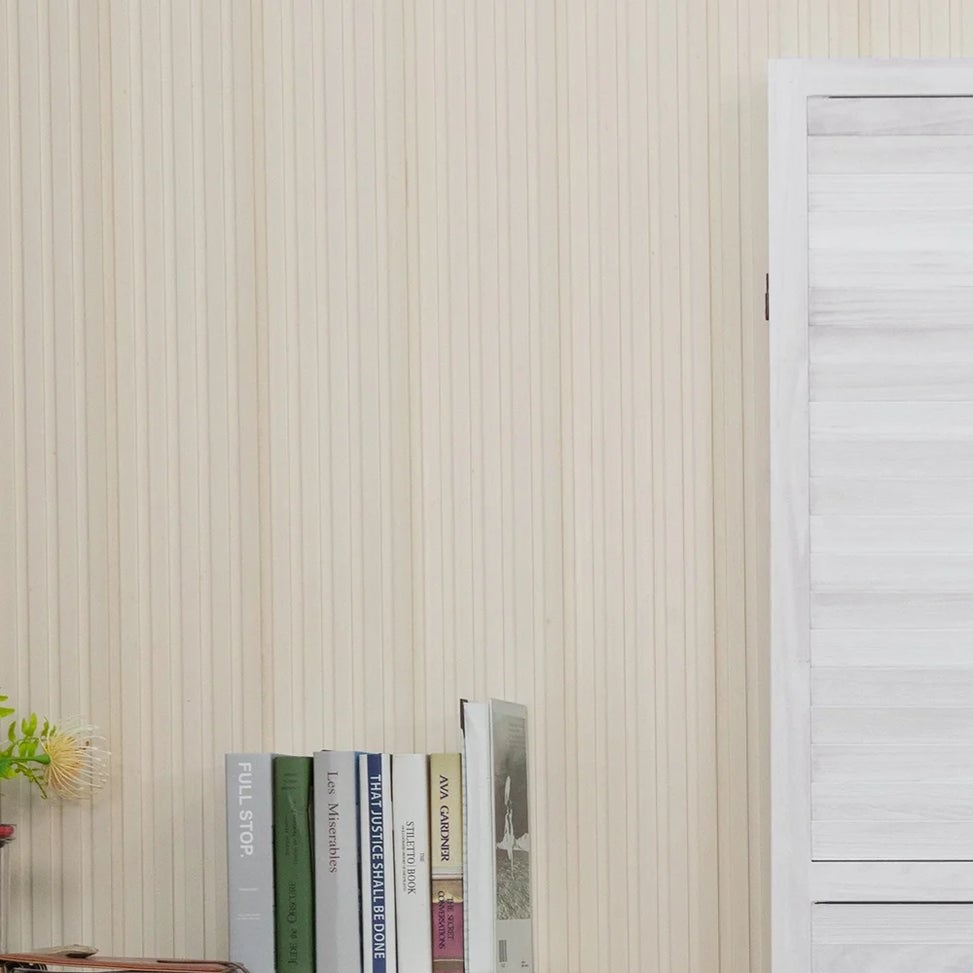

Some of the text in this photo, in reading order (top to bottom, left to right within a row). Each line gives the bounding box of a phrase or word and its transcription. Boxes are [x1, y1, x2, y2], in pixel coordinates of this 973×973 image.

[238, 762, 254, 858] FULL STOP.
[327, 772, 341, 873] Les Miserables
[406, 821, 416, 895] STILETTO BOOK
[439, 775, 451, 862] AVA GARDNER
[370, 774, 386, 959] THAT JUSTICE SHALL BE DONE
